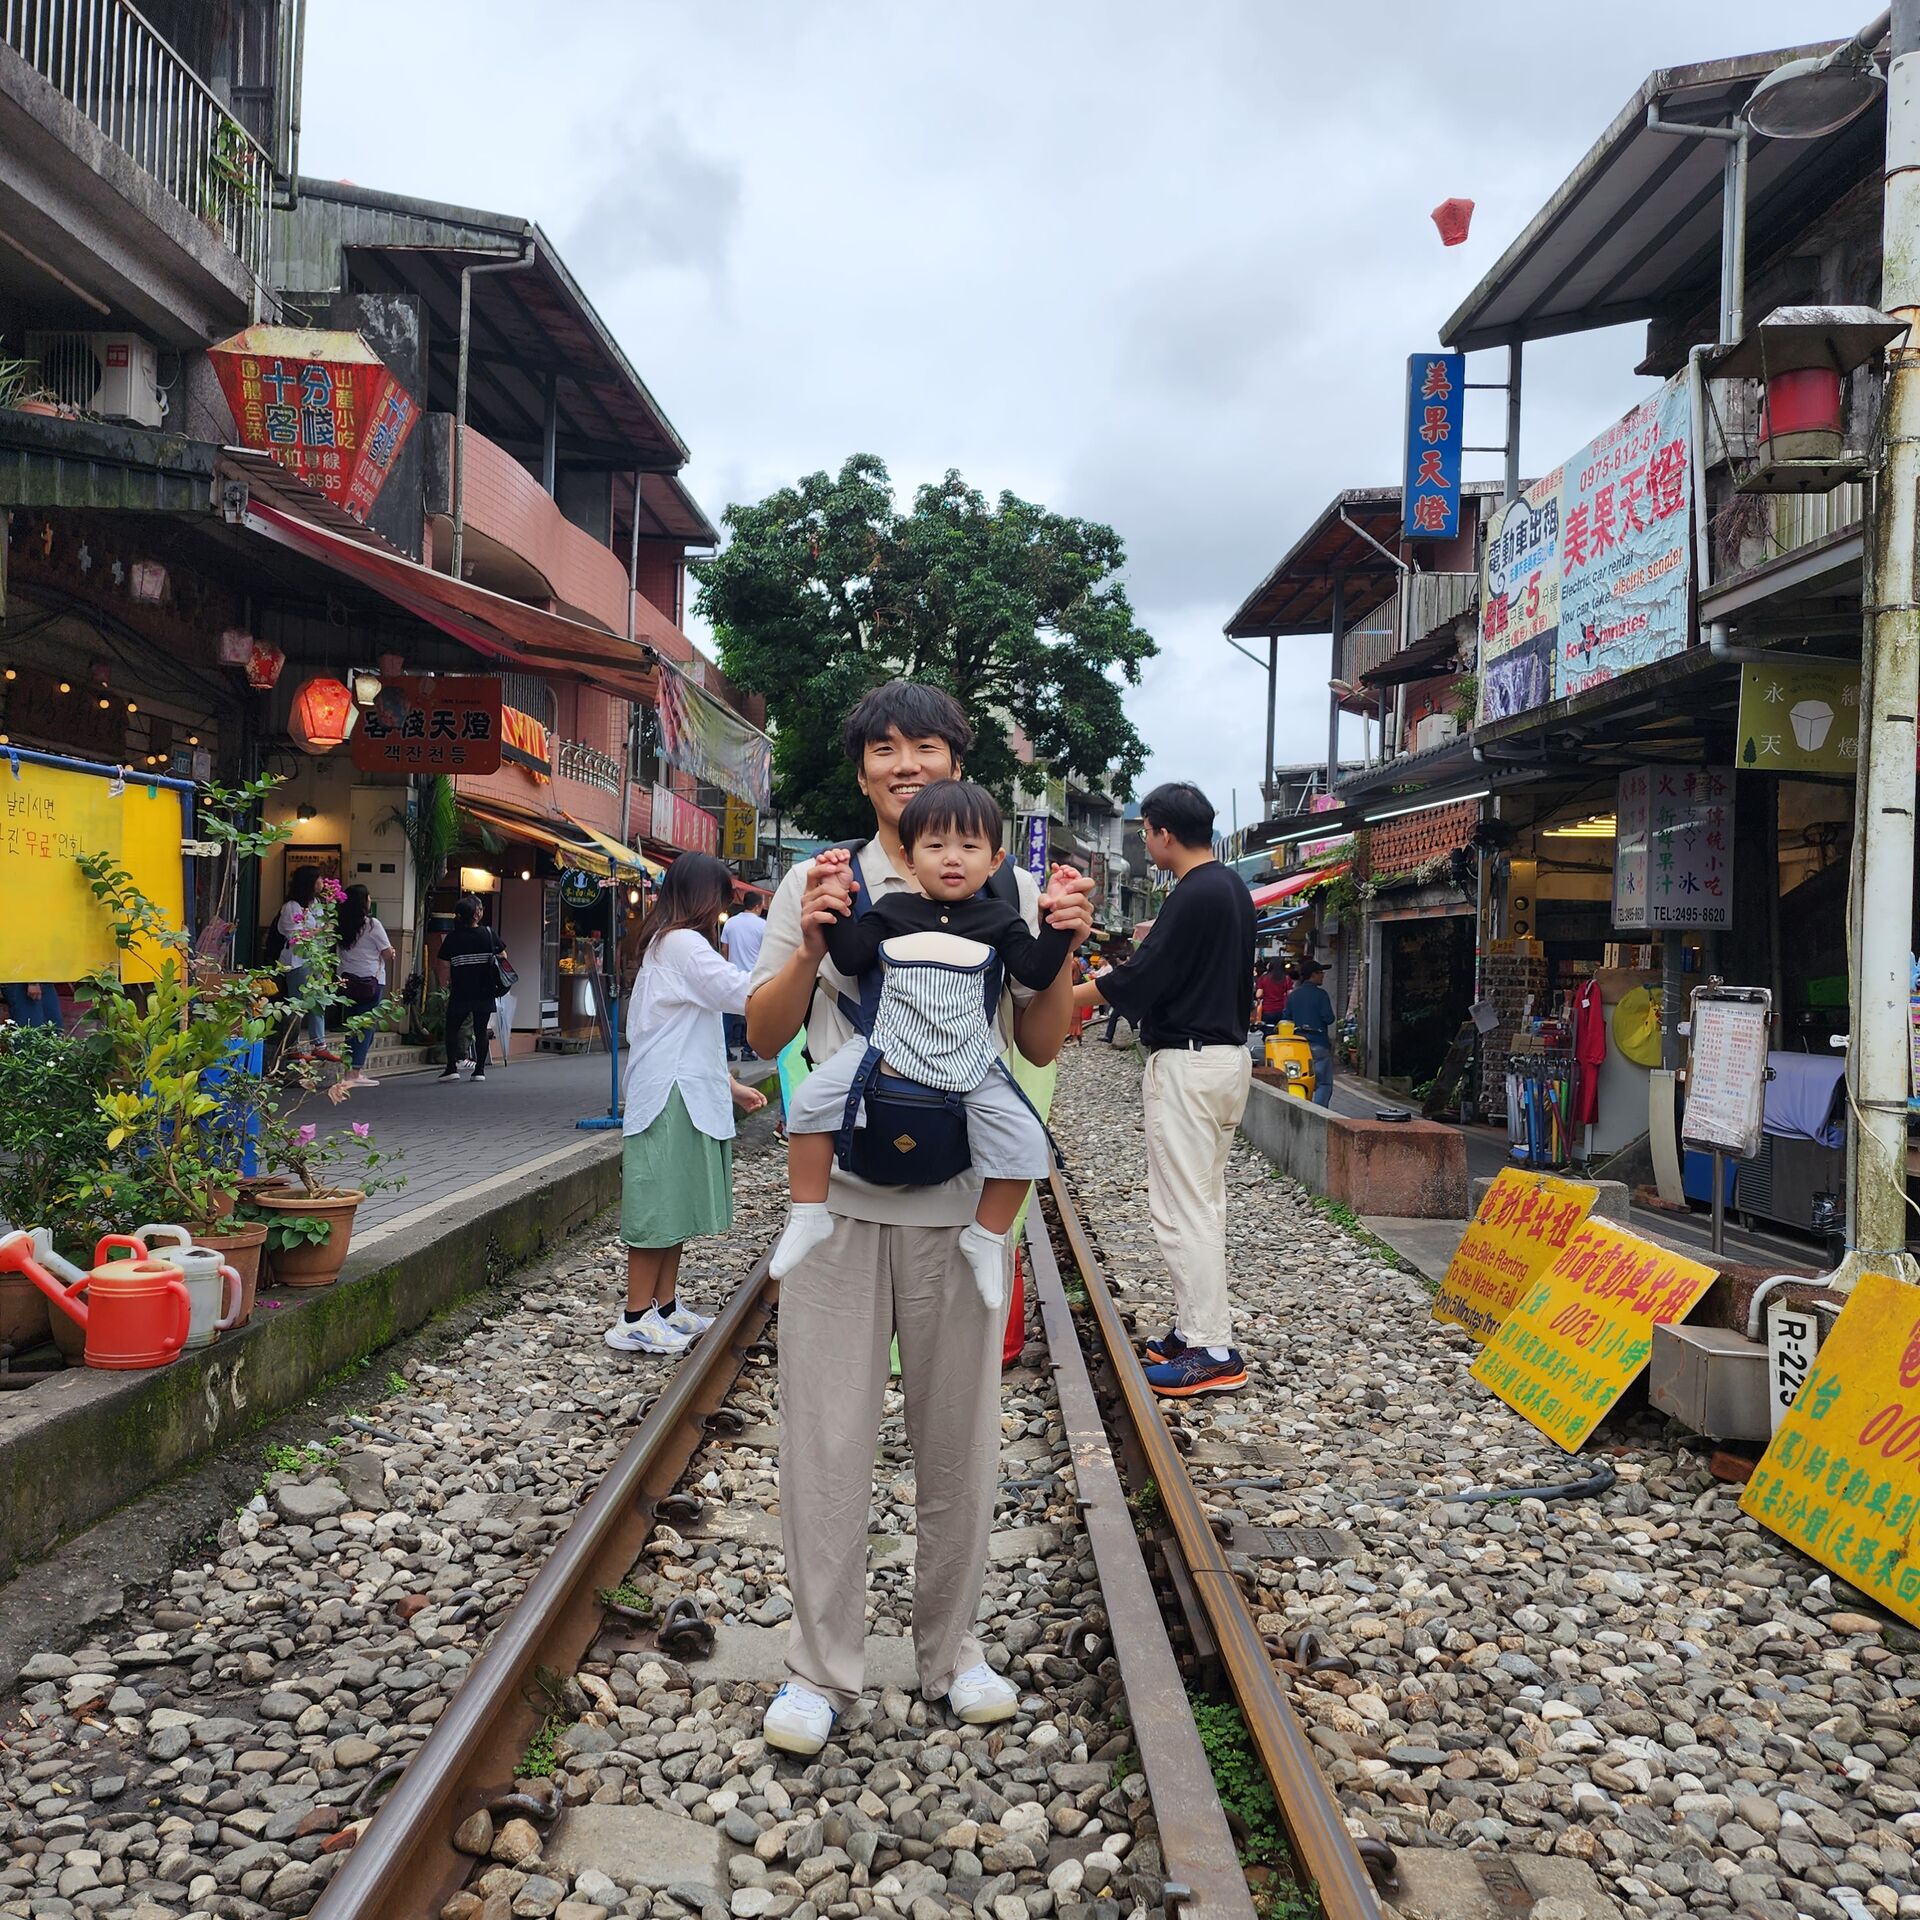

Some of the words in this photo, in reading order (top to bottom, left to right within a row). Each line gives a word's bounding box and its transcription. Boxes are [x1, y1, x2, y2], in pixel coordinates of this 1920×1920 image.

[262, 361, 333, 407] 十分
[264, 403, 336, 448] 客棧
[335, 369, 356, 450] 山產小吃
[1413, 360, 1452, 531] 美果天燈
[1564, 438, 1688, 577] 美果天燈
[1489, 496, 1558, 574] 電動車出租
[1562, 573, 1590, 600] Electric
[1592, 566, 1606, 582] car
[1608, 548, 1634, 575] rental
[1562, 609, 1575, 626] You
[1577, 602, 1589, 618] can
[1592, 590, 1612, 609] take
[1613, 569, 1645, 597] electric
[1566, 641, 1580, 660] For
[1585, 625, 1595, 652] 5
[1599, 613, 1647, 645] minutes
[1762, 682, 1784, 704] 永
[384, 744, 468, 764] 객잔천등
[1760, 734, 1781, 756] 天
[6, 791, 56, 821] 날리시면
[1656, 805, 1677, 896] 新鮮果汁
[1704, 806, 1726, 897] 傳統小吃
[1653, 906, 1726, 922] TEL:2495-8620
[1458, 1235, 1476, 1260] Auto
[1476, 1241, 1495, 1266] Bike
[1495, 1248, 1530, 1283] Renting
[1552, 1230, 1701, 1324] 前面電動車出租
[1436, 1288, 1450, 1314] Only
[1448, 1260, 1458, 1281] To
[1458, 1266, 1473, 1288] the
[1472, 1270, 1498, 1300] Water
[1496, 1282, 1518, 1309] Fall
[1793, 1367, 1842, 1421] 1台
[1858, 1403, 1920, 1462] 00
